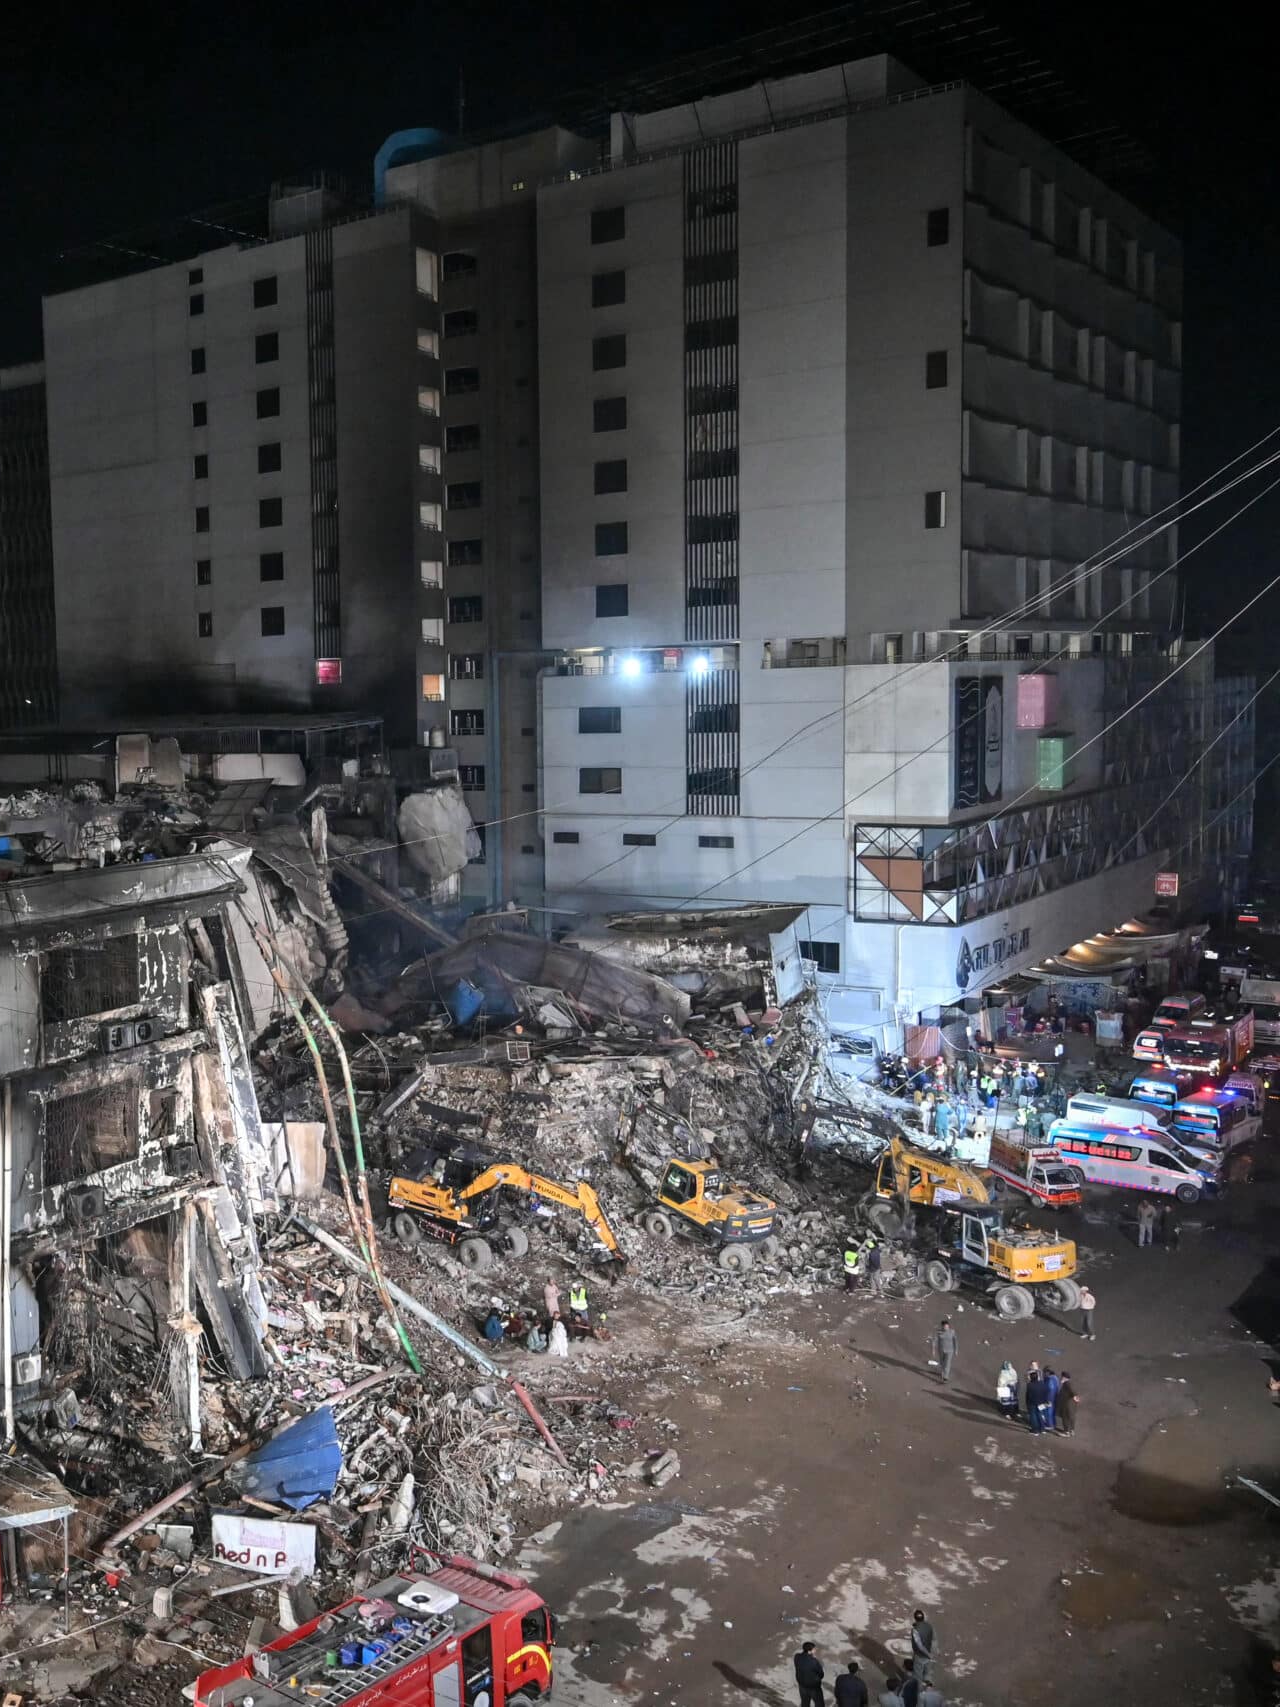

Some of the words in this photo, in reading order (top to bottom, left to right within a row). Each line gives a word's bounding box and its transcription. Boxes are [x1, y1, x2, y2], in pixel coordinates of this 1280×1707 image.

[645, 1107, 668, 1125] VOLVO
[832, 1115, 860, 1126] VOLVO
[214, 1542, 251, 1565] Red
[256, 1554, 267, 1567] n
